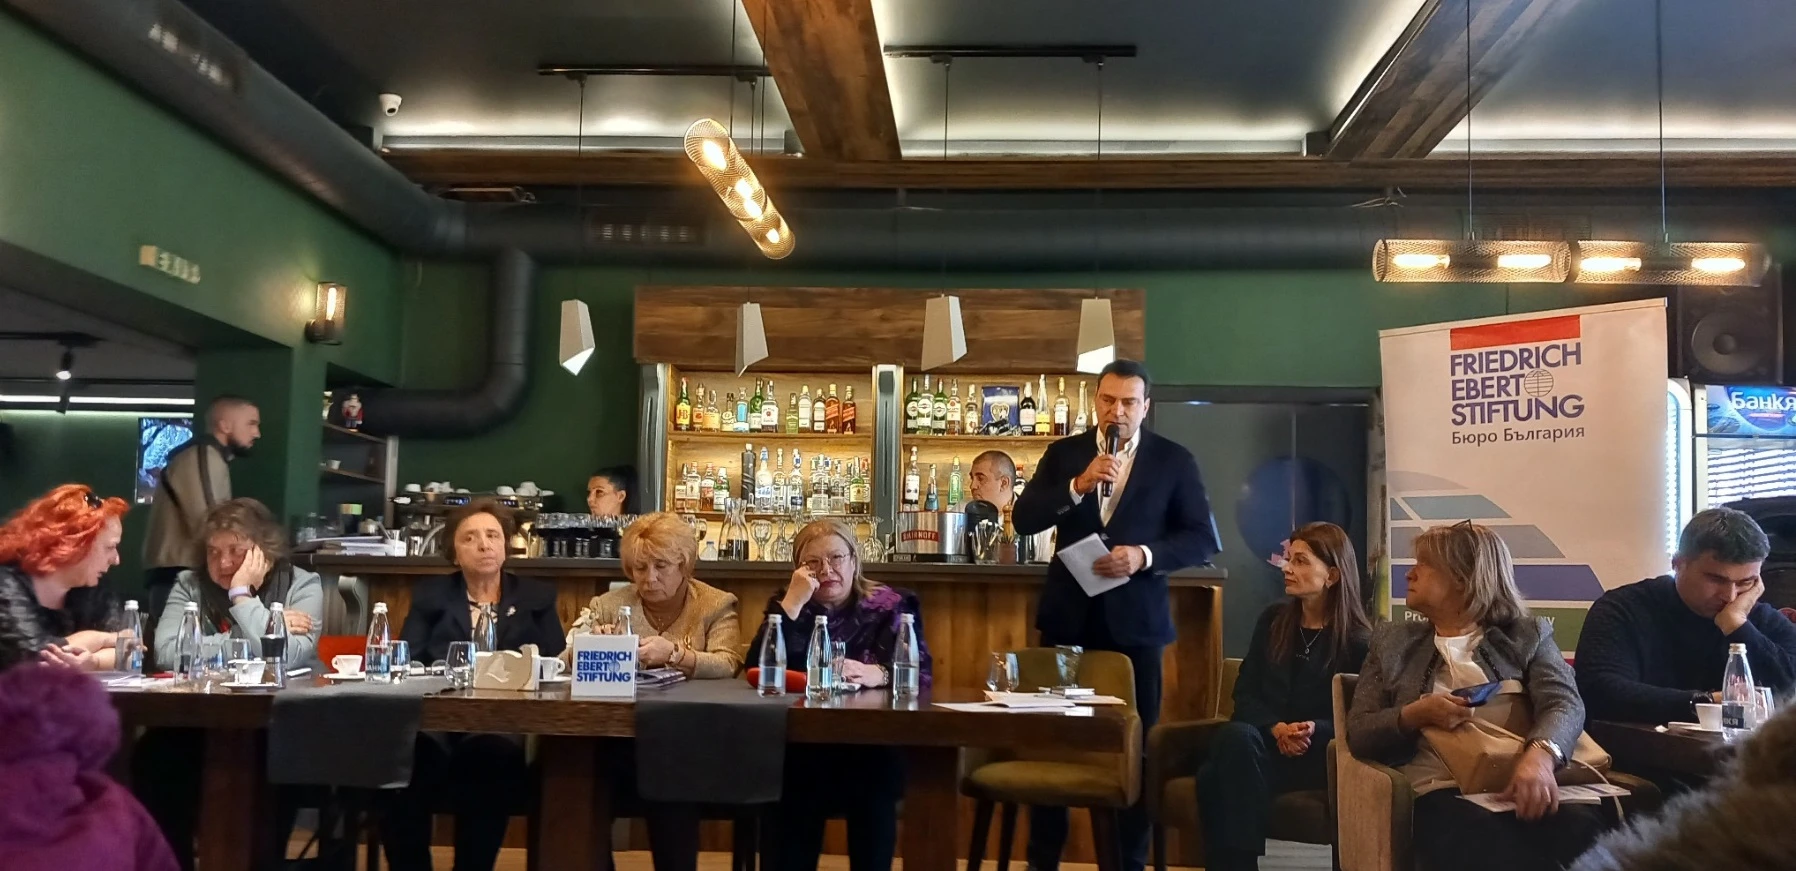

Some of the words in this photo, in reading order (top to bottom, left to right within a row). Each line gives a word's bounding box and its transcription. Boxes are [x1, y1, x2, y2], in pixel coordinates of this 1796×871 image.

[1450, 342, 1582, 376] FRIEDRICH
[1451, 373, 1525, 401] EBERT
[1451, 394, 1585, 426] STIFTUNG
[1452, 431, 1498, 447] Бюро
[1504, 427, 1585, 443] България
[577, 651, 632, 661] FRIEDRICH
[577, 661, 609, 671] EBERT
[577, 671, 632, 682] STIFTUNG
